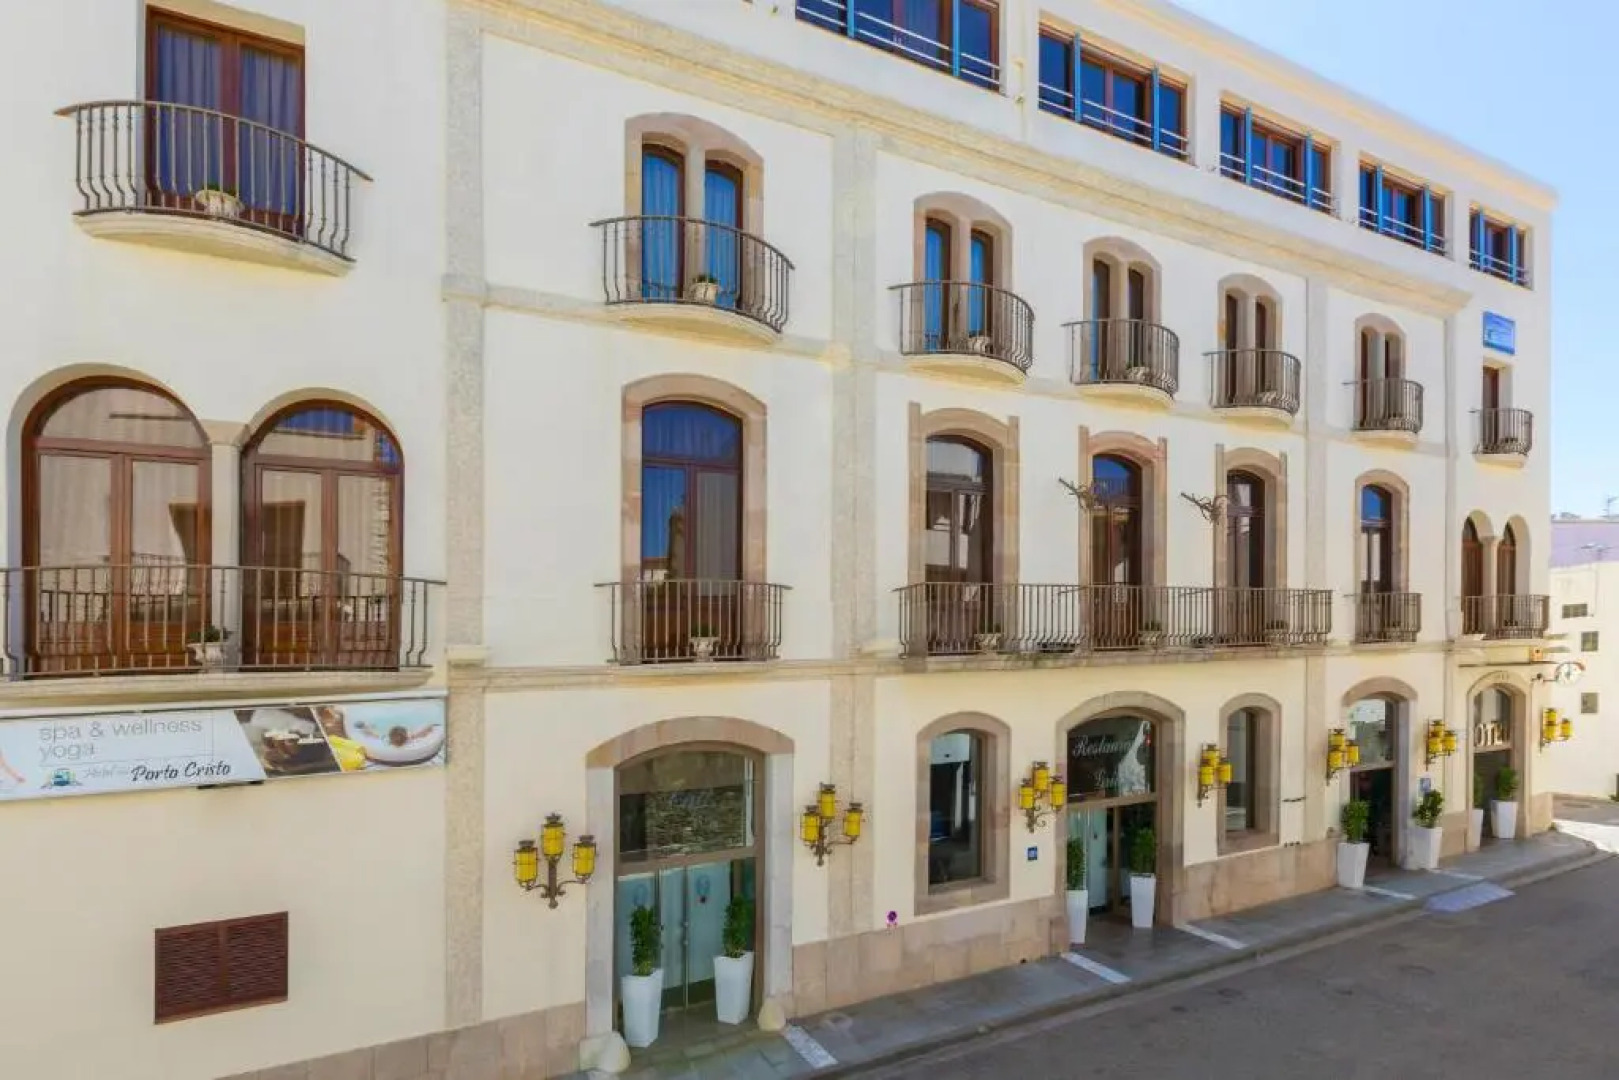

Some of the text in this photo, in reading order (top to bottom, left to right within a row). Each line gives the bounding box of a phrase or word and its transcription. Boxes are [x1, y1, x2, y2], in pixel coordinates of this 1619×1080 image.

[39, 717, 203, 744] spa & wellness
[39, 742, 95, 763] yoga
[130, 763, 180, 781] Porto
[183, 760, 232, 778] Cristo
